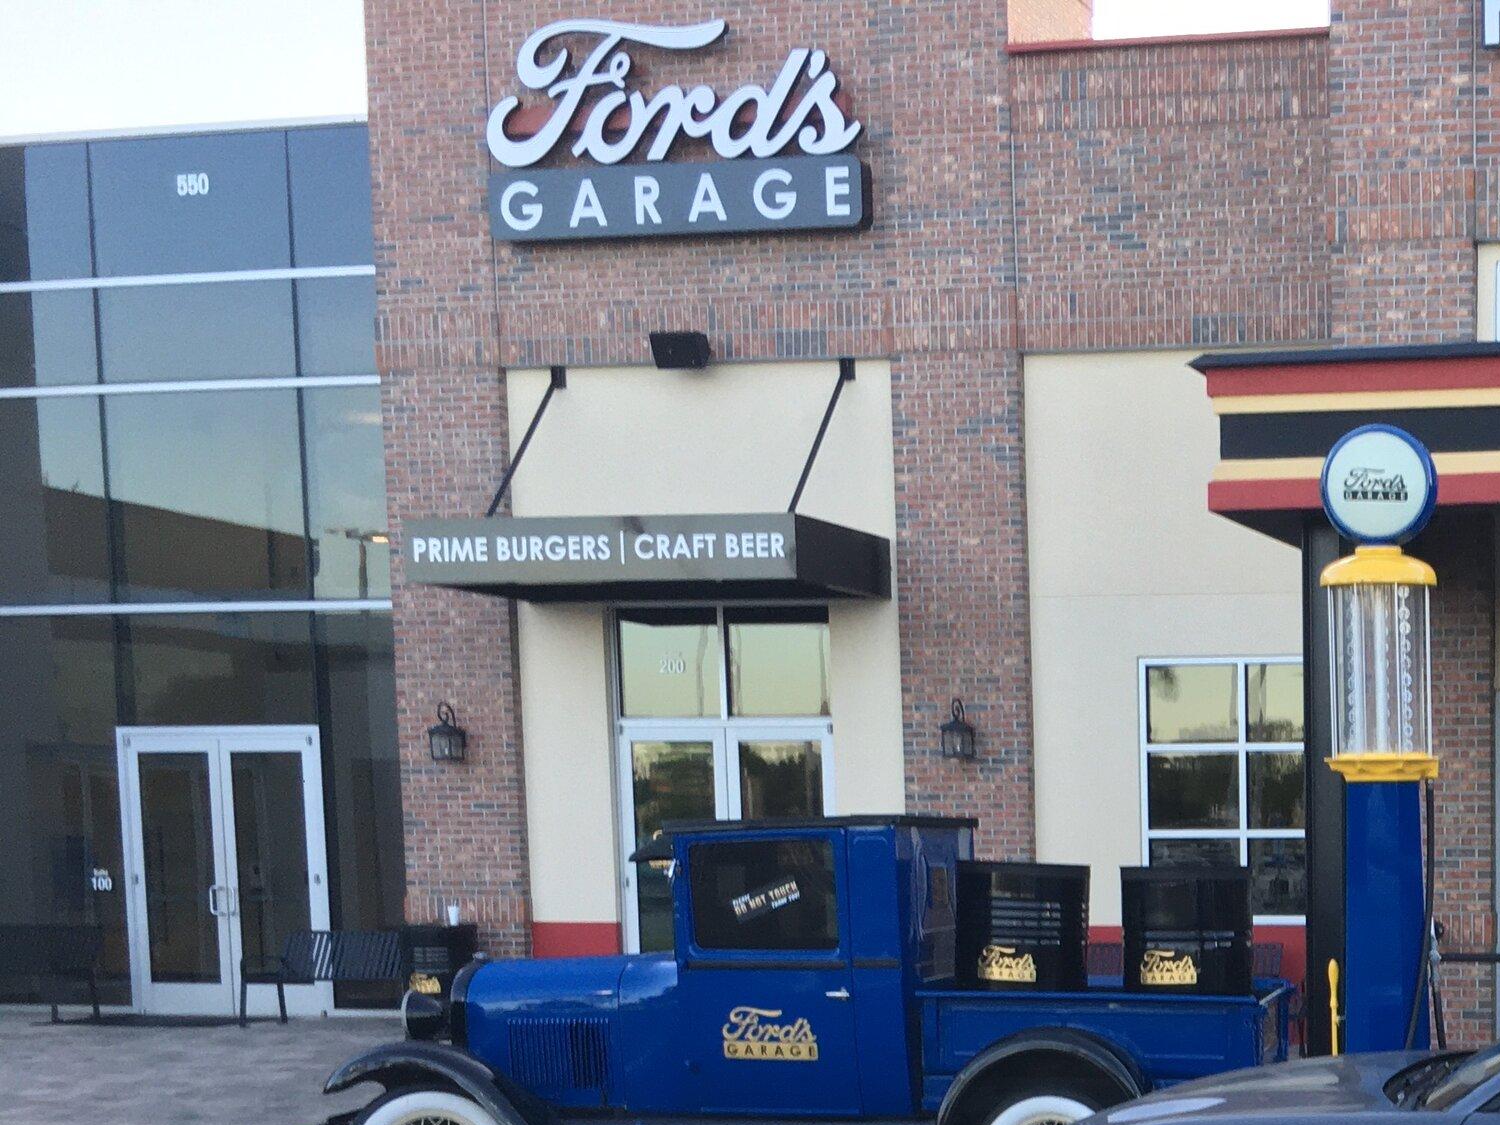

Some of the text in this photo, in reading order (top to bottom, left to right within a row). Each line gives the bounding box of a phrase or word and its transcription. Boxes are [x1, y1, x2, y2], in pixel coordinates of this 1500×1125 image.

[486, 18, 862, 168] Ford's
[176, 172, 210, 197] 550
[500, 166, 852, 232] GARAGE
[413, 537, 488, 563] PRIME
[496, 534, 610, 562] BURGERS
[634, 532, 717, 560] CRAFT
[725, 532, 785, 558] BEER
[660, 659, 685, 674] 200
[92, 876, 112, 891] 100
[748, 893, 767, 910] NOT
[768, 880, 798, 901] TOUCH
[722, 1006, 817, 1043] Ford's
[726, 1043, 817, 1057] GARAGE
